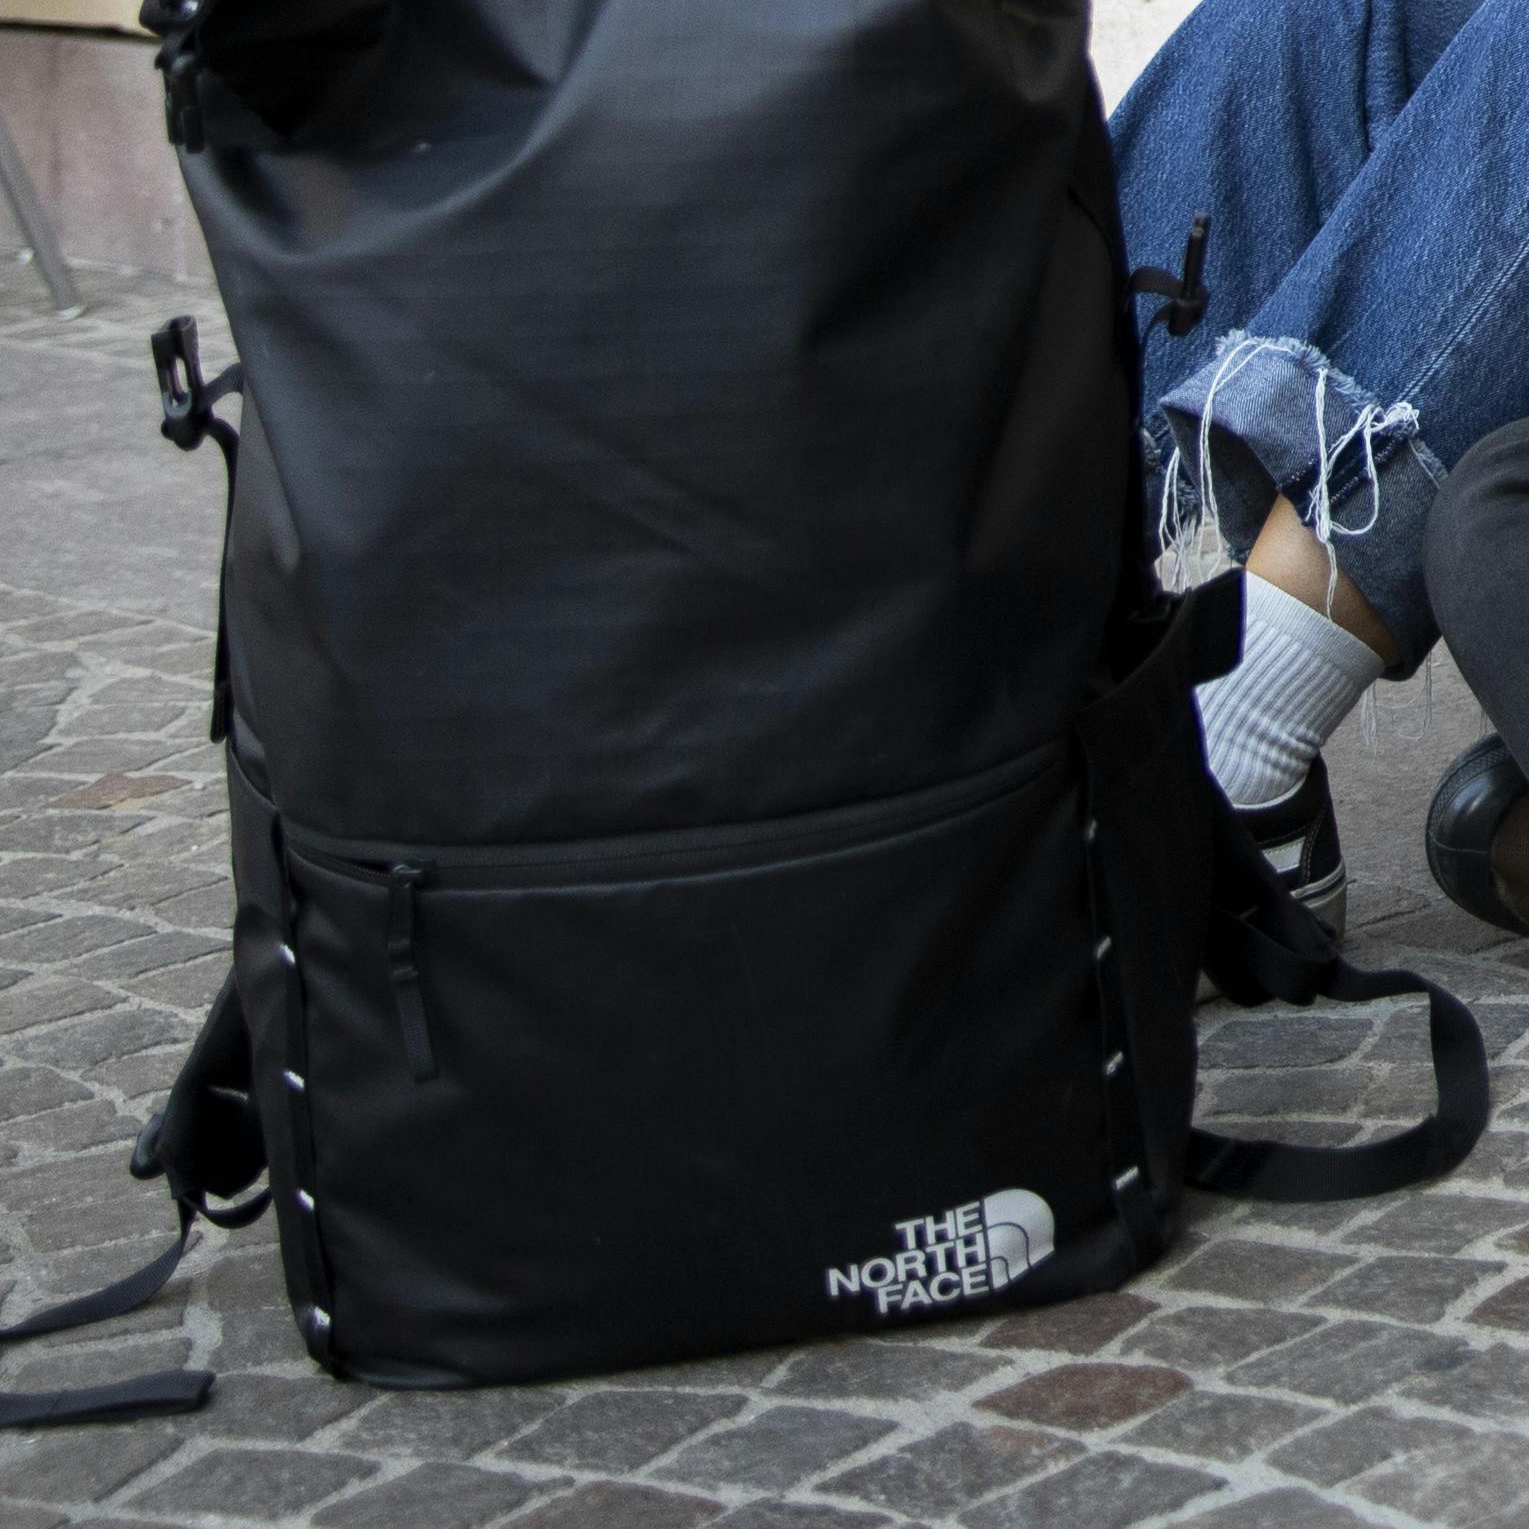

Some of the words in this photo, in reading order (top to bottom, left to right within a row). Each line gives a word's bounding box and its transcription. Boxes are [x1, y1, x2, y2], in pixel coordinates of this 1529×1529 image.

[895, 1201, 983, 1251] THE
[828, 1233, 986, 1297] NORTH
[878, 1263, 989, 1314] FACE
